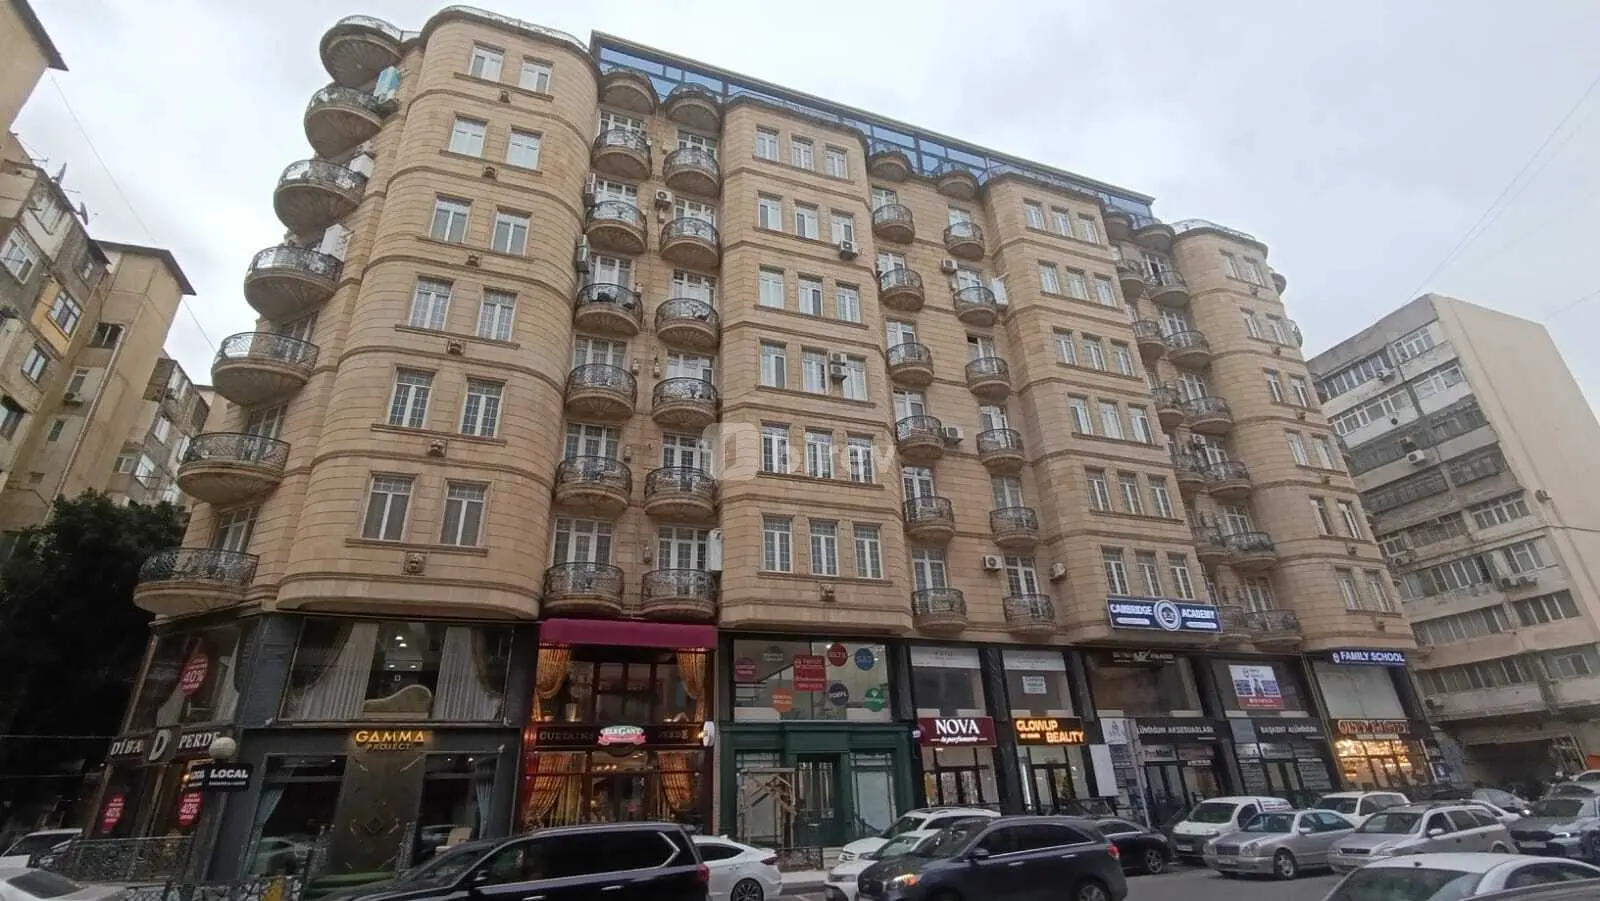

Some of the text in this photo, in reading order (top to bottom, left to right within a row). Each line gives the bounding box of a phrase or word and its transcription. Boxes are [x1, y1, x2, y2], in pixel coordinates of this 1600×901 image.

[1109, 603, 1216, 619] CAMBRIDGE ACADEMY
[1340, 650, 1406, 662] FAMILY SCHOOL
[935, 718, 980, 735] NOVA
[1015, 719, 1059, 732] GLOWUP
[355, 730, 425, 743] GAMMA
[1045, 731, 1085, 743] BEAUTY
[149, 729, 172, 761] D
[366, 742, 411, 750] PROJECT
[209, 768, 249, 779] LOCAL
